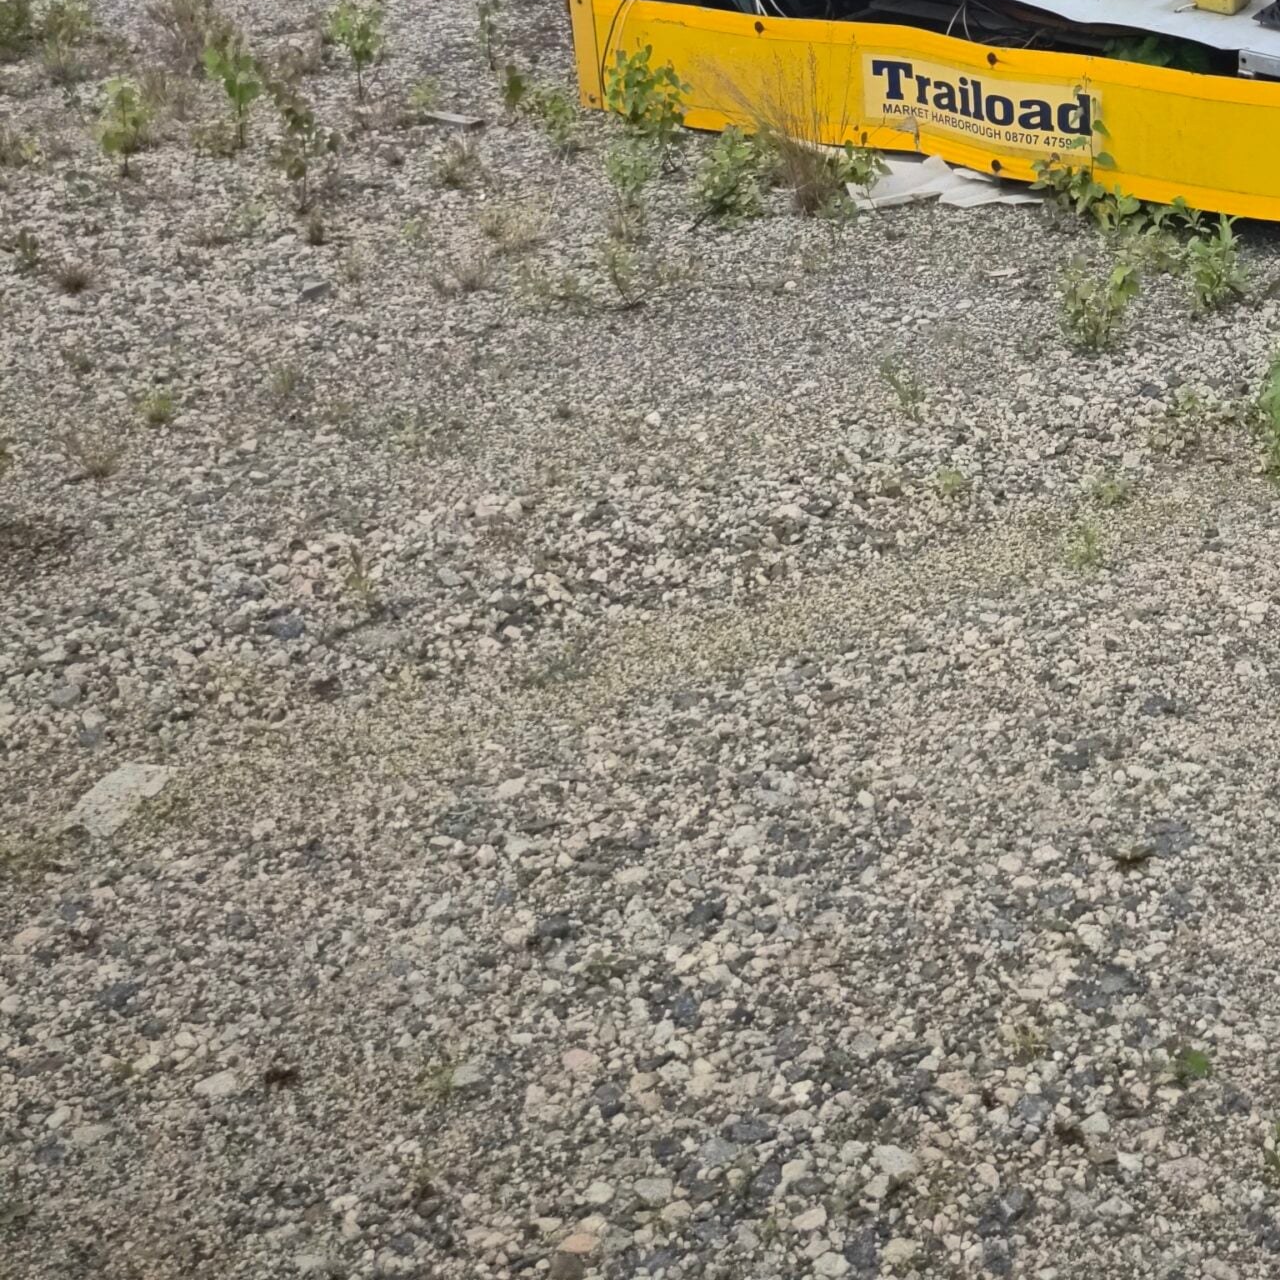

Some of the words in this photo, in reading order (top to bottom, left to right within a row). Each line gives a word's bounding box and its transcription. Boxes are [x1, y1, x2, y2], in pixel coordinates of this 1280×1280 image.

[872, 59, 1093, 136] Traiload
[882, 103, 929, 120] MARKET
[932, 111, 1001, 139] HARBOROUGH
[1005, 132, 1040, 145] 08707
